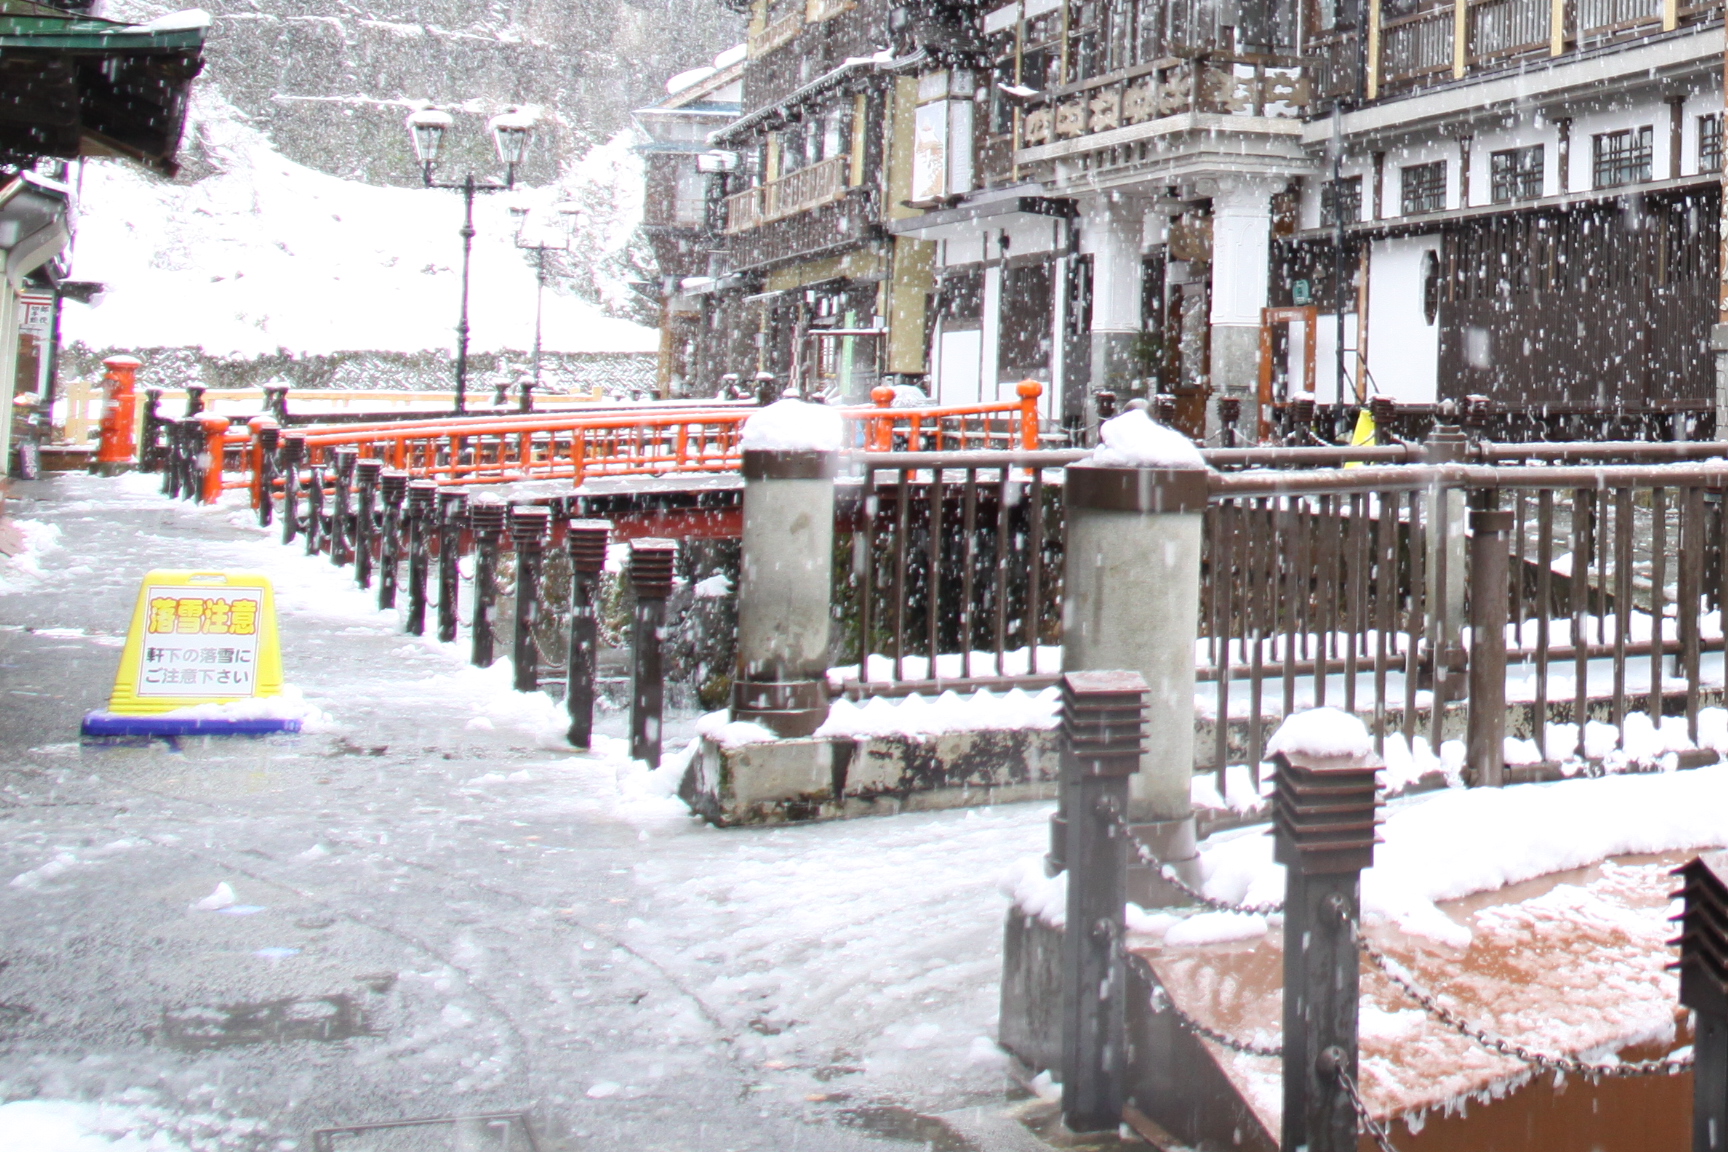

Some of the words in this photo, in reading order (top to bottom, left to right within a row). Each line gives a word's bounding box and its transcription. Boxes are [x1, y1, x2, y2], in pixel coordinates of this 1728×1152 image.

[148, 597, 257, 634] 落雪注意
[147, 647, 250, 663] 軒下の落雪に
[146, 668, 248, 684] ご注意下さい
